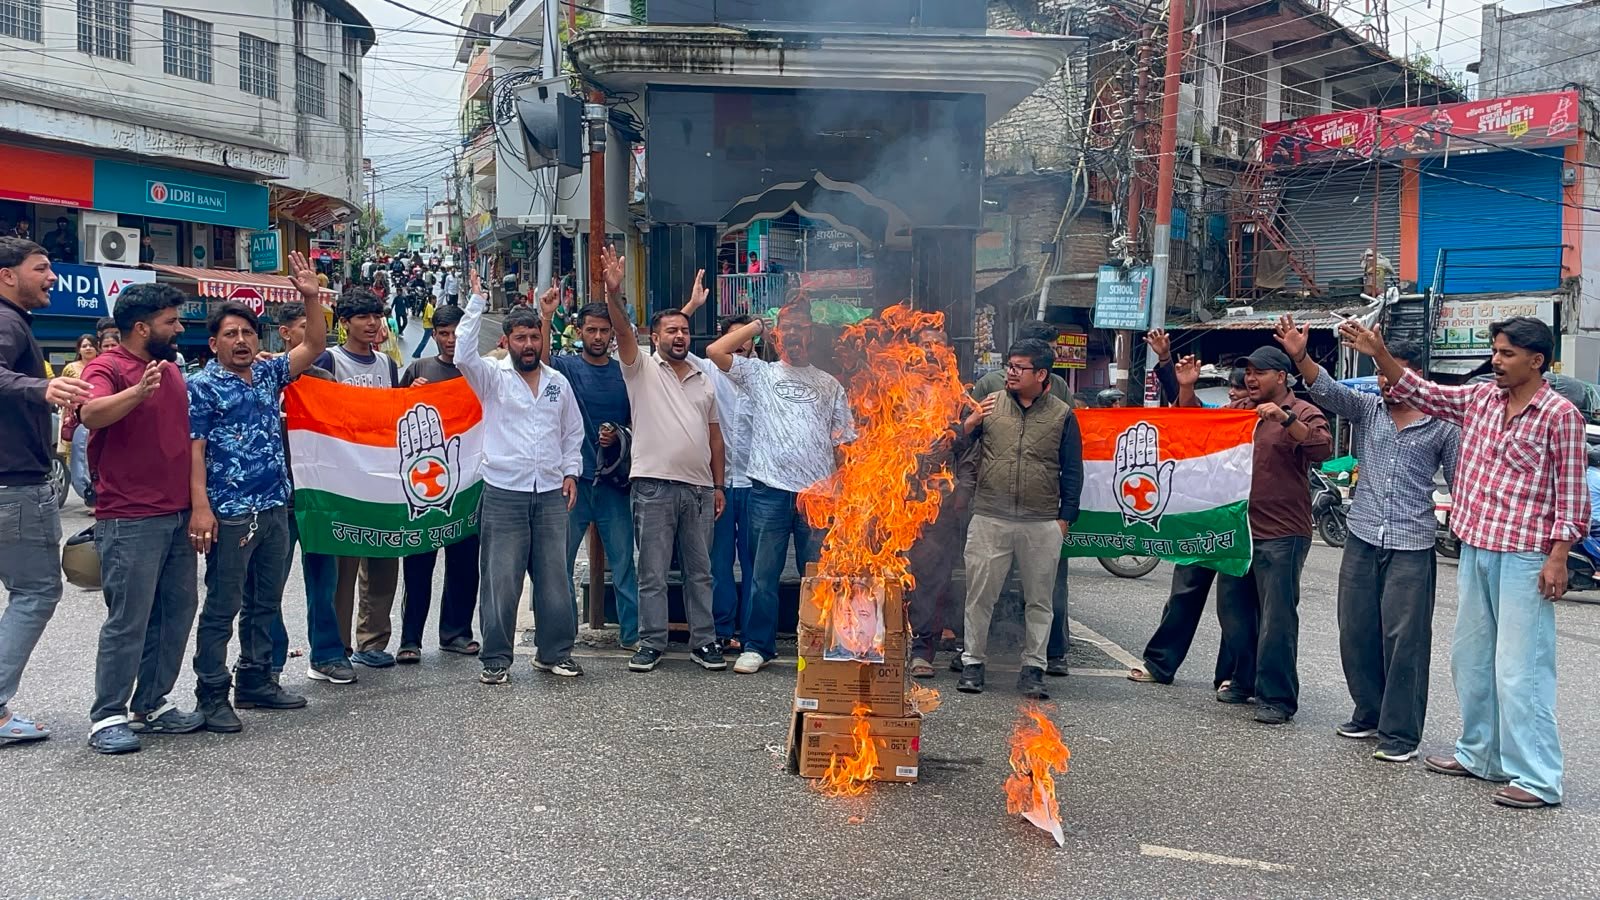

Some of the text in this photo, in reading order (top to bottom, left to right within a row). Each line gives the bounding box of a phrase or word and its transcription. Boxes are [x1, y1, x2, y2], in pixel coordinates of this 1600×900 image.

[170, 189, 222, 207] IDBI BANK
[253, 236, 275, 252] ATM
[50, 274, 98, 295] NDI
[1109, 285, 1134, 295] SCHOOL
[332, 521, 423, 547] उत्तराखंड
[428, 519, 463, 548] युवा
[1140, 538, 1174, 555] युवा
[1177, 529, 1236, 553] कांग्रेस
[878, 668, 900, 678] 1.00
